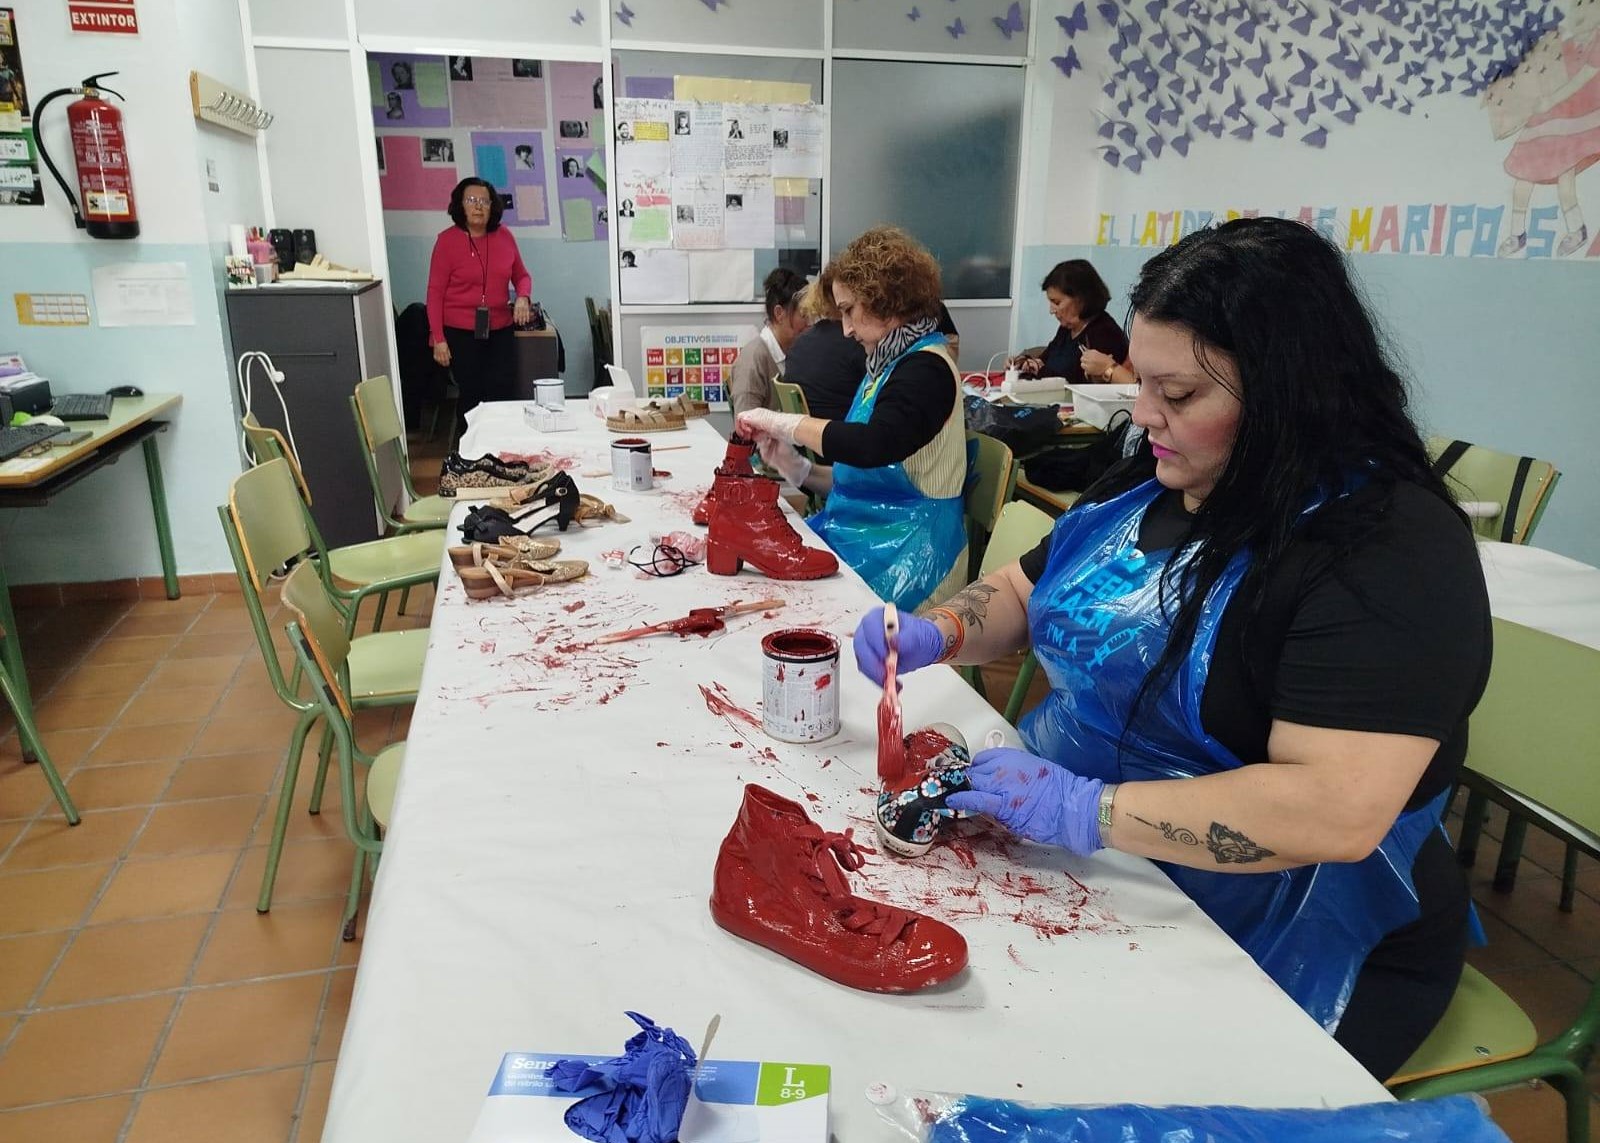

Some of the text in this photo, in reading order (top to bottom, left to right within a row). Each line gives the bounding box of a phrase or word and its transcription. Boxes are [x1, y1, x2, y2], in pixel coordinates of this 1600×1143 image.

[71, 11, 136, 28] EXTINTOR
[1096, 211, 1120, 246] EL
[1348, 203, 1600, 258] MARIPOS
[664, 335, 710, 344] OBJETIVOS
[782, 1066, 805, 1087] L
[780, 1087, 806, 1100] 8-9
